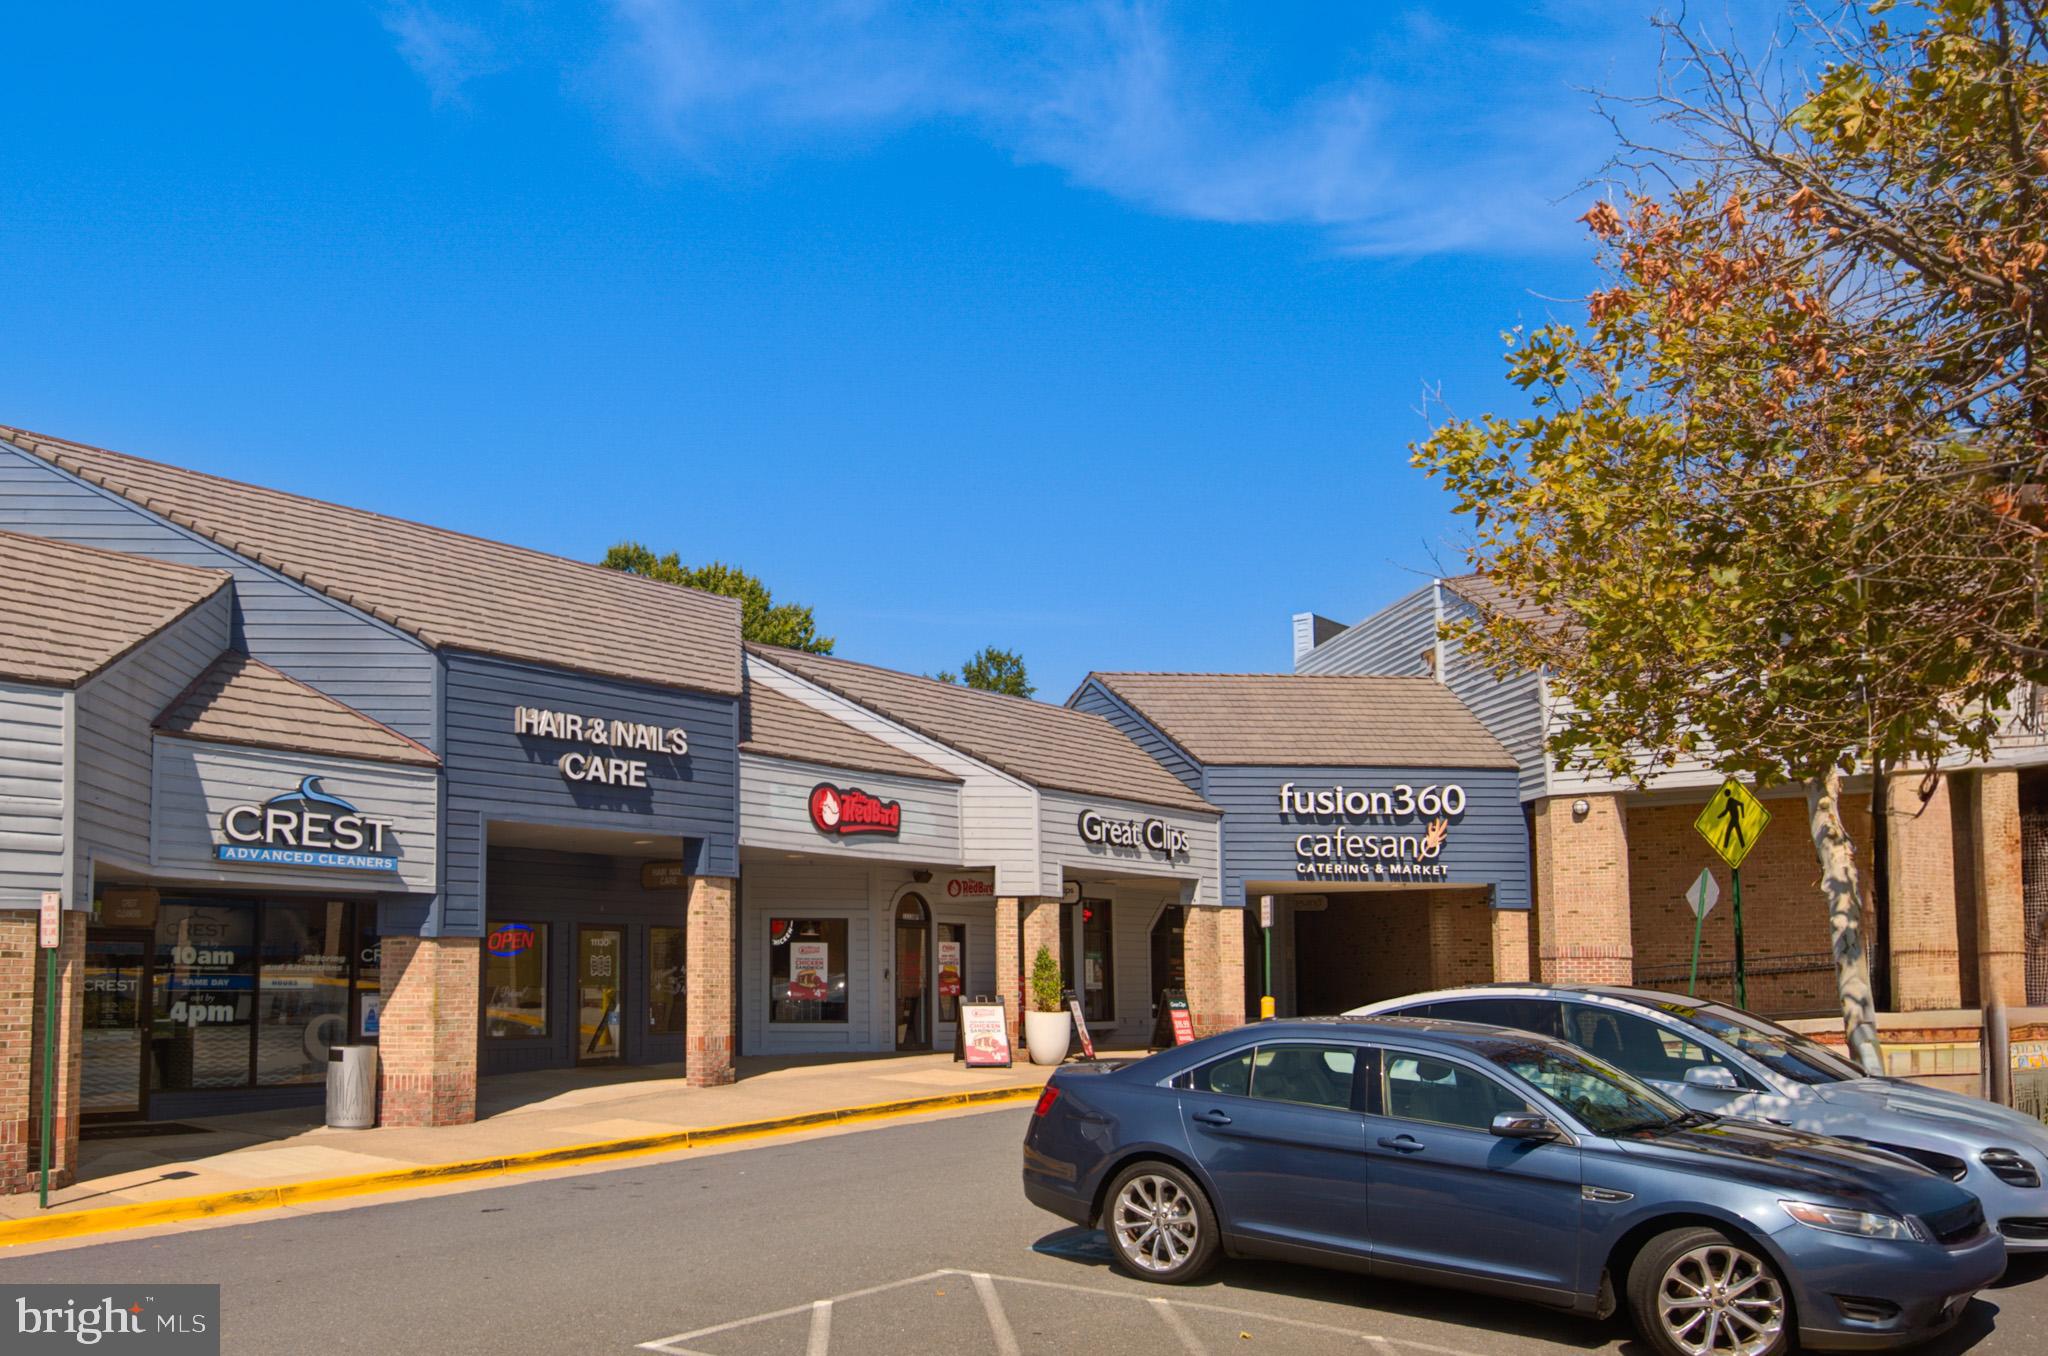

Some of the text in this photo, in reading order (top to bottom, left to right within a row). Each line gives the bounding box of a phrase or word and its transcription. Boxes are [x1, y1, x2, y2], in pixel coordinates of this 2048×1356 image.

[516, 706, 688, 755] HAIR & NAILS
[562, 753, 647, 787] CARE
[1279, 783, 1466, 815] fusion360
[225, 805, 393, 852] CREST
[1082, 811, 1190, 858] Great Clips
[1296, 826, 1440, 859] cafesano
[225, 848, 392, 868] ADVANCED CLEANERS
[1296, 863, 1448, 875] CATERING & MARKET
[487, 931, 535, 950] OPEN
[170, 946, 234, 965] 10am
[84, 980, 137, 992] CREST
[170, 1001, 234, 1027] 4pm
